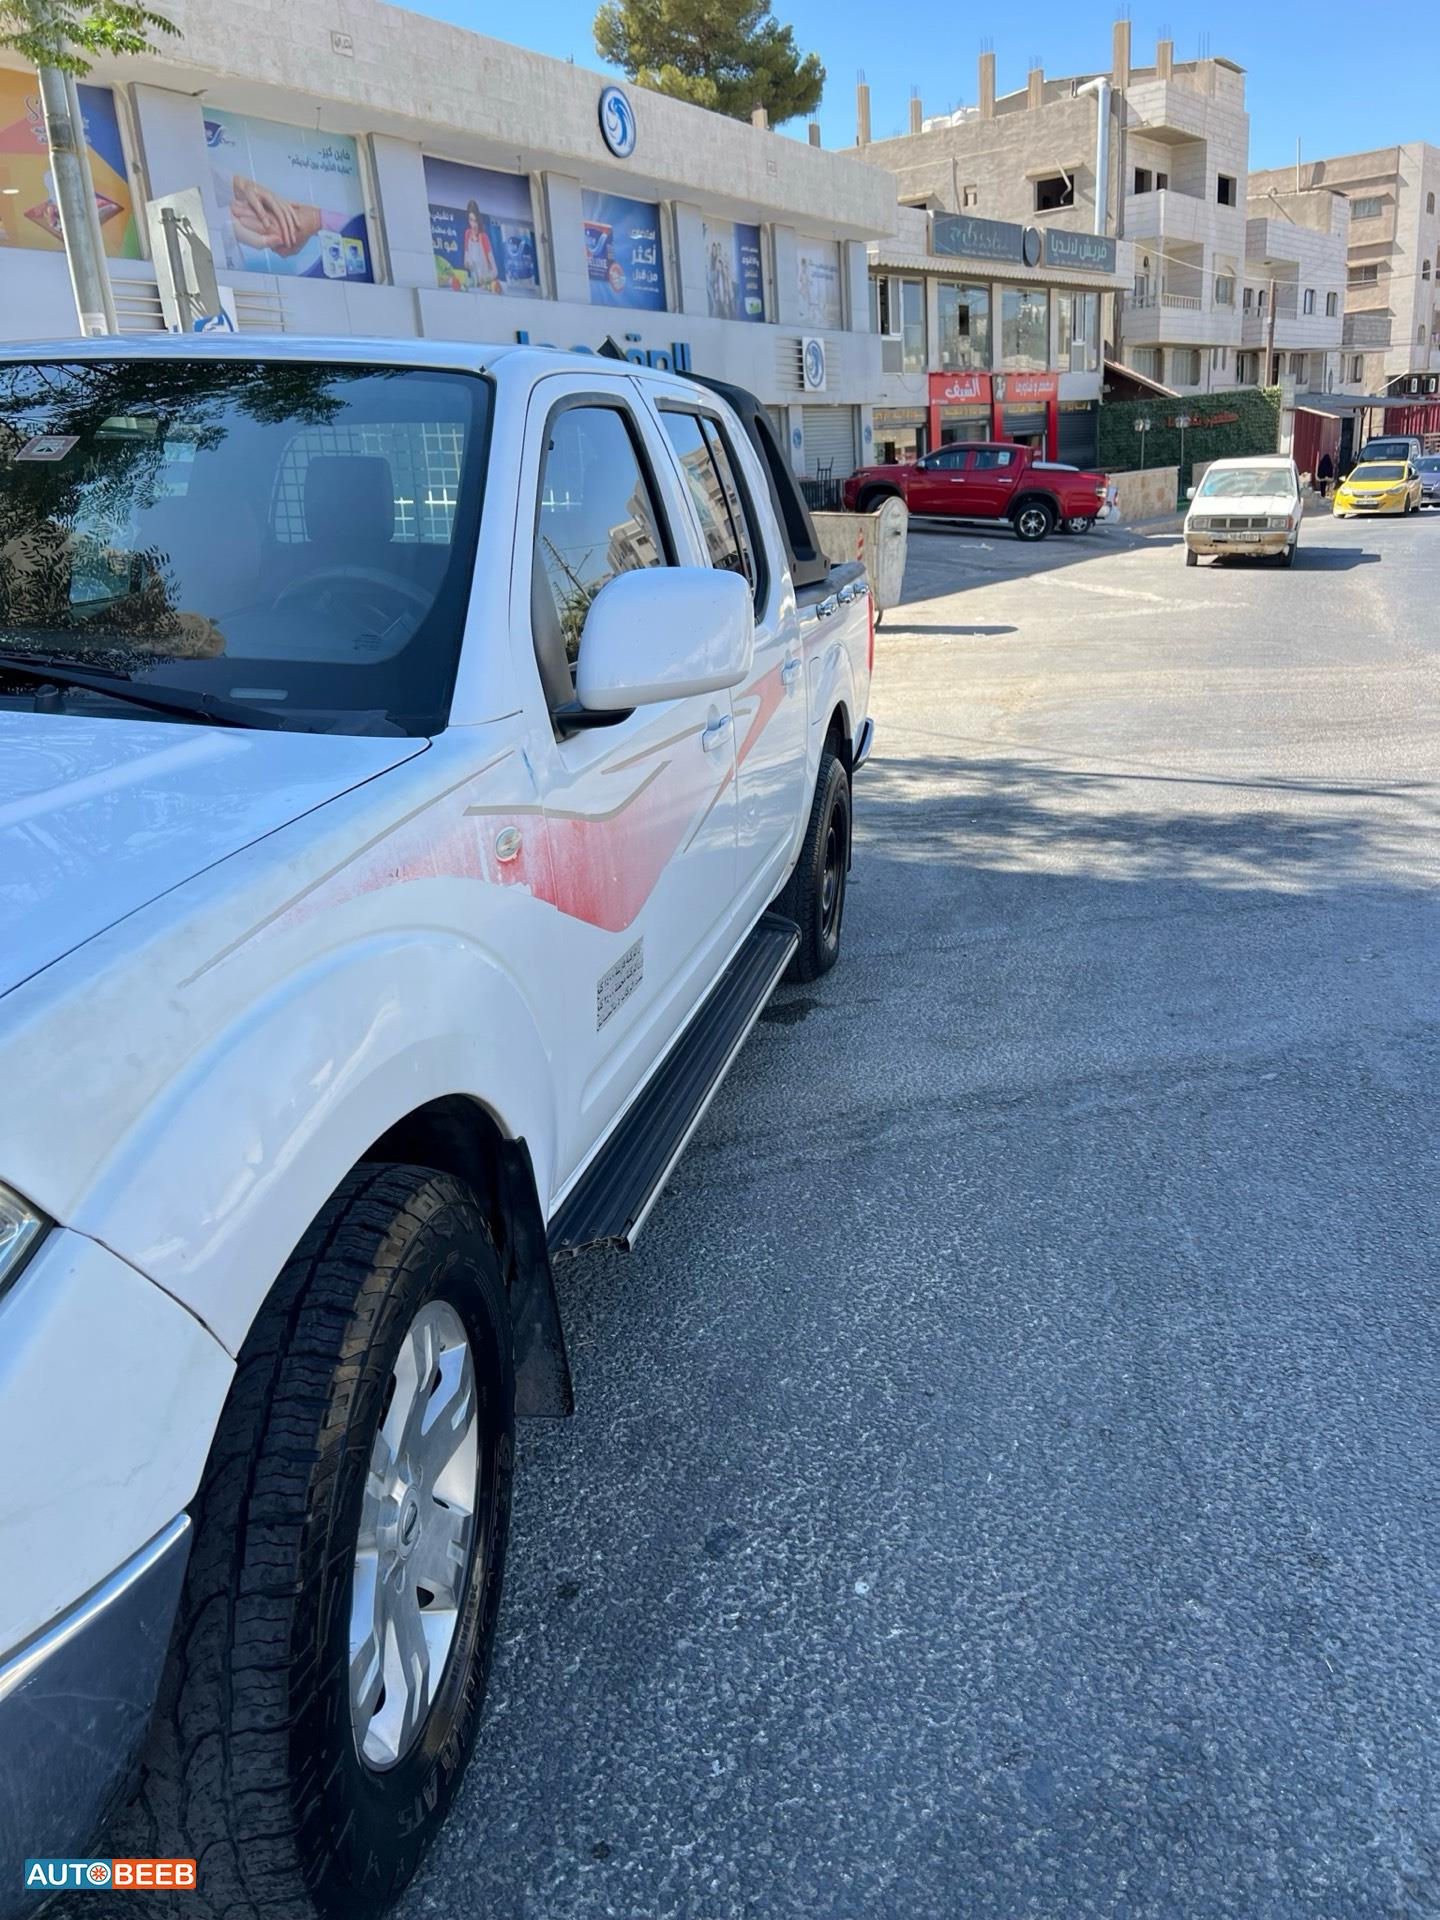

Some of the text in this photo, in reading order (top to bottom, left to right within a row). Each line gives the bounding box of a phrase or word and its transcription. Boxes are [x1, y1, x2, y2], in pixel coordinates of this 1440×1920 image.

[630, 243, 657, 265] أكثر
[1051, 233, 1078, 257] لانديا
[944, 376, 981, 401] الشيف
